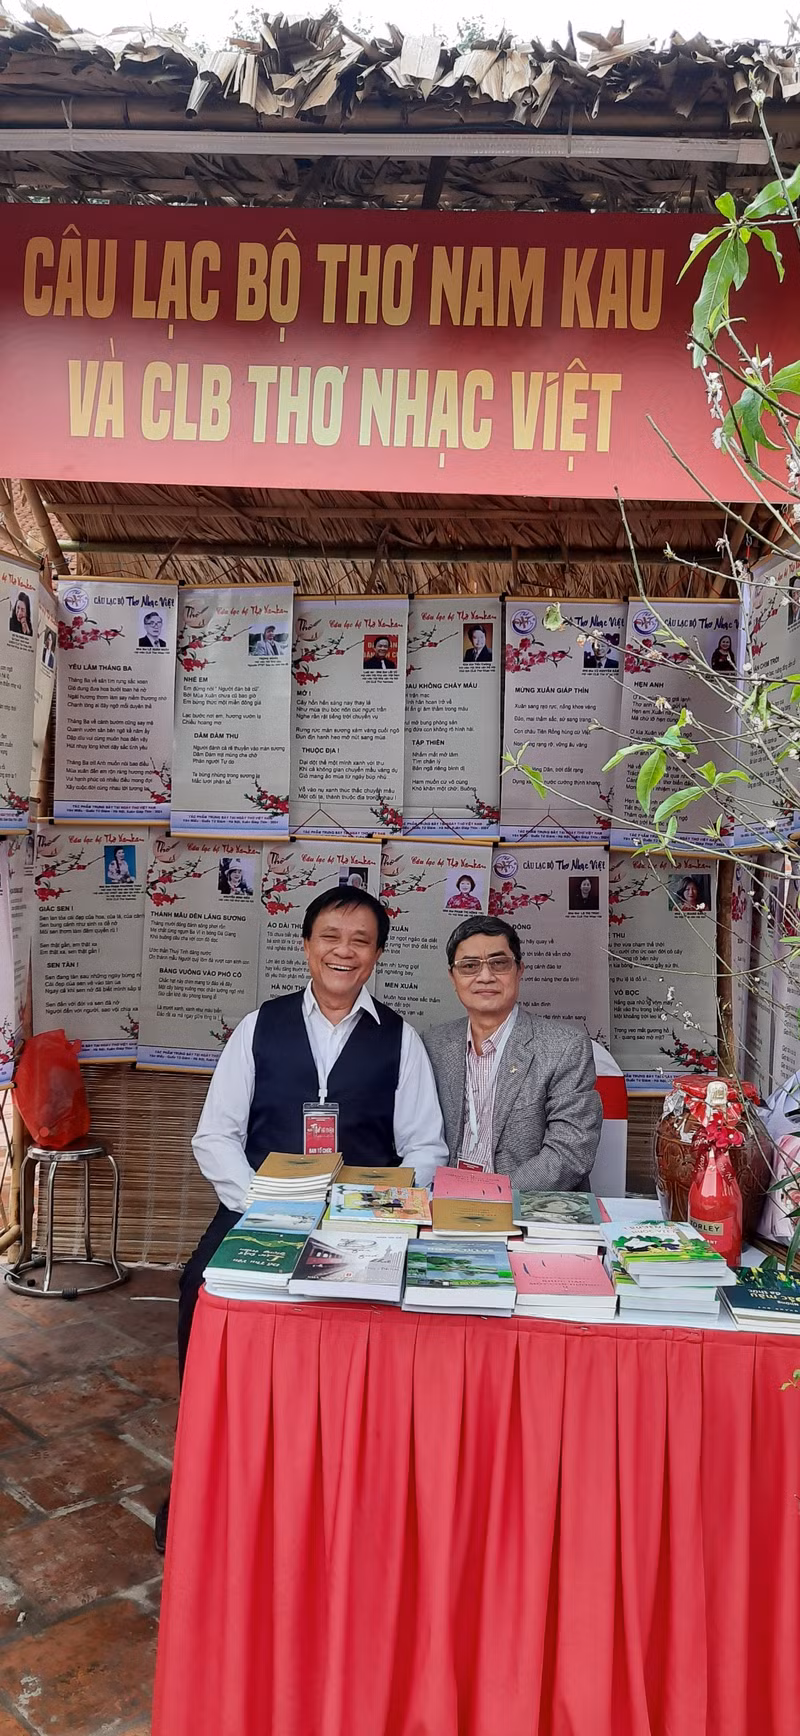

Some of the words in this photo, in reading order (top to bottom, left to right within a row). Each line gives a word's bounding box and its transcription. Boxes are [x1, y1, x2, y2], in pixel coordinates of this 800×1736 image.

[24, 224, 118, 317] CÂU
[132, 240, 220, 339] LẠC
[236, 228, 301, 342] BỘ
[317, 243, 417, 326] THƠ
[430, 246, 544, 327] NAM
[561, 248, 664, 331] KAU
[68, 337, 125, 438] VÀ
[141, 361, 231, 442] CLB
[248, 366, 349, 446] THƠ
[360, 367, 493, 468] NHẠC
